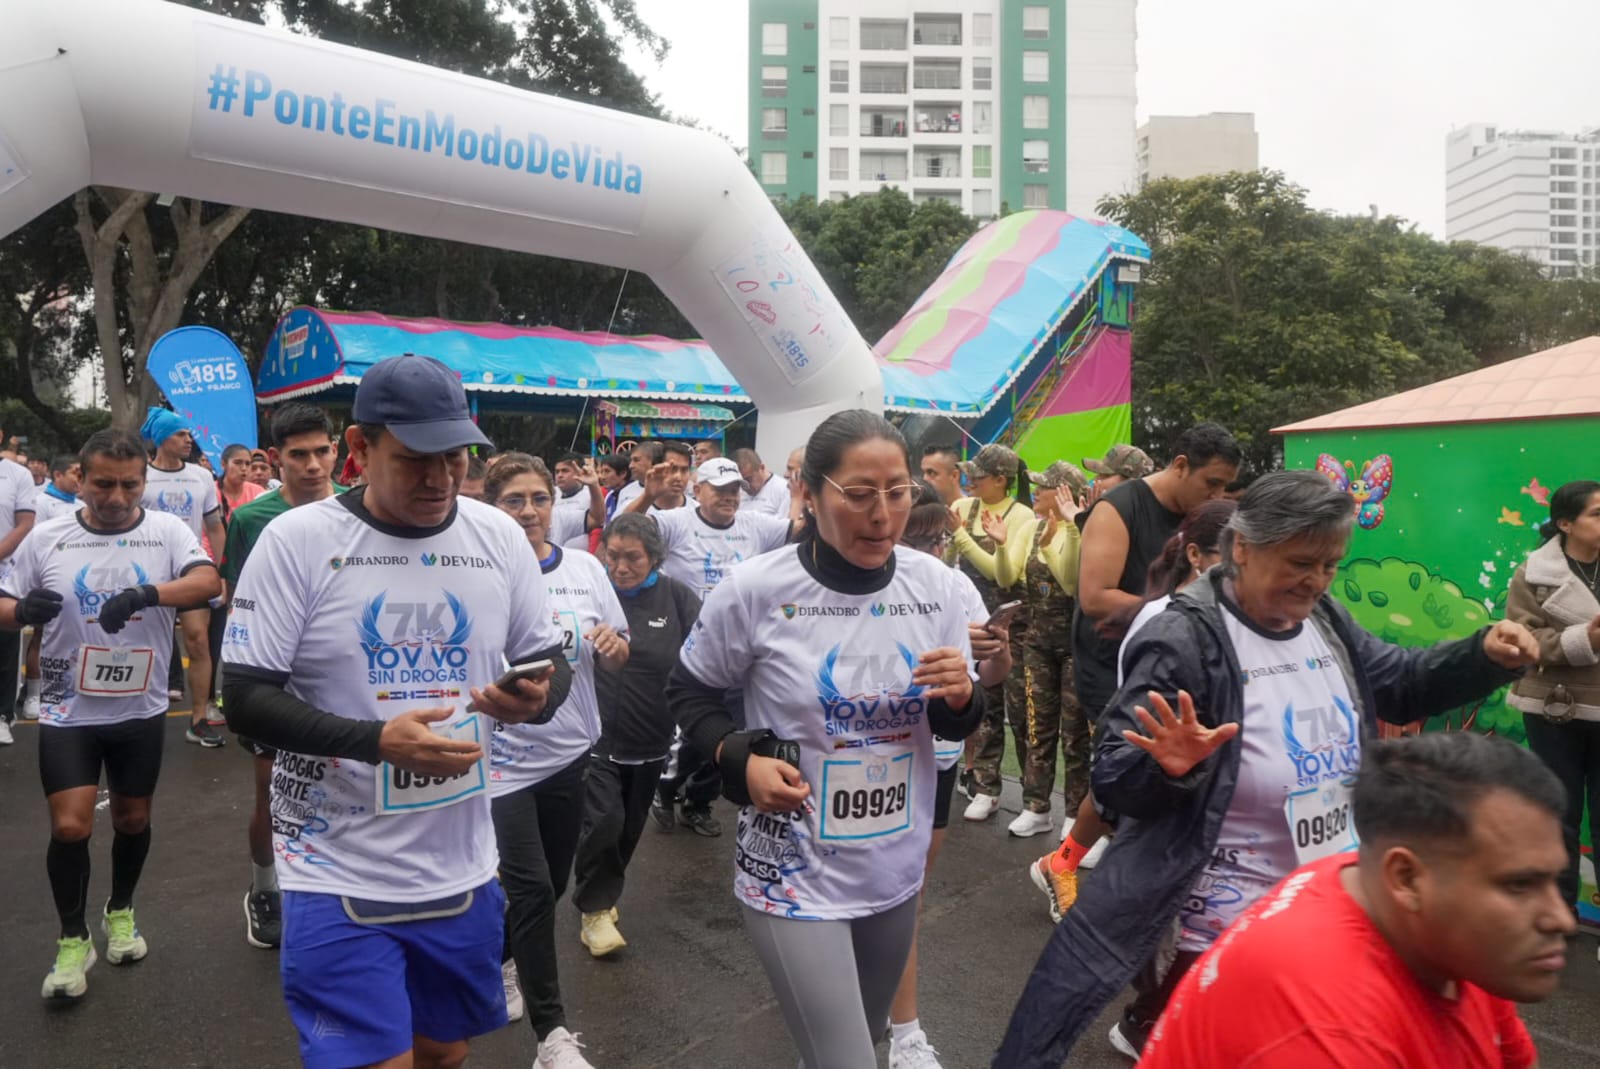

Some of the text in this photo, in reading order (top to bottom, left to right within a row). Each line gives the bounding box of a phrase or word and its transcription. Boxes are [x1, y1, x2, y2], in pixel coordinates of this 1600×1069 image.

[207, 64, 642, 194] #PonteEnModoDeVida
[787, 339, 809, 368] 1815
[191, 362, 238, 384] 1815
[129, 539, 164, 548] DEVIDA
[440, 554, 494, 570] DEVIDA
[80, 605, 98, 616] SIN
[799, 605, 861, 617] DIRANDRO
[888, 601, 943, 617] DEVIDA
[384, 602, 448, 642] 7K
[95, 664, 134, 682] 7757
[367, 667, 467, 685] SIN DROGAS
[825, 714, 921, 737] SIN DROGAS
[832, 781, 907, 821] 09929
[1296, 802, 1350, 849] 09926
